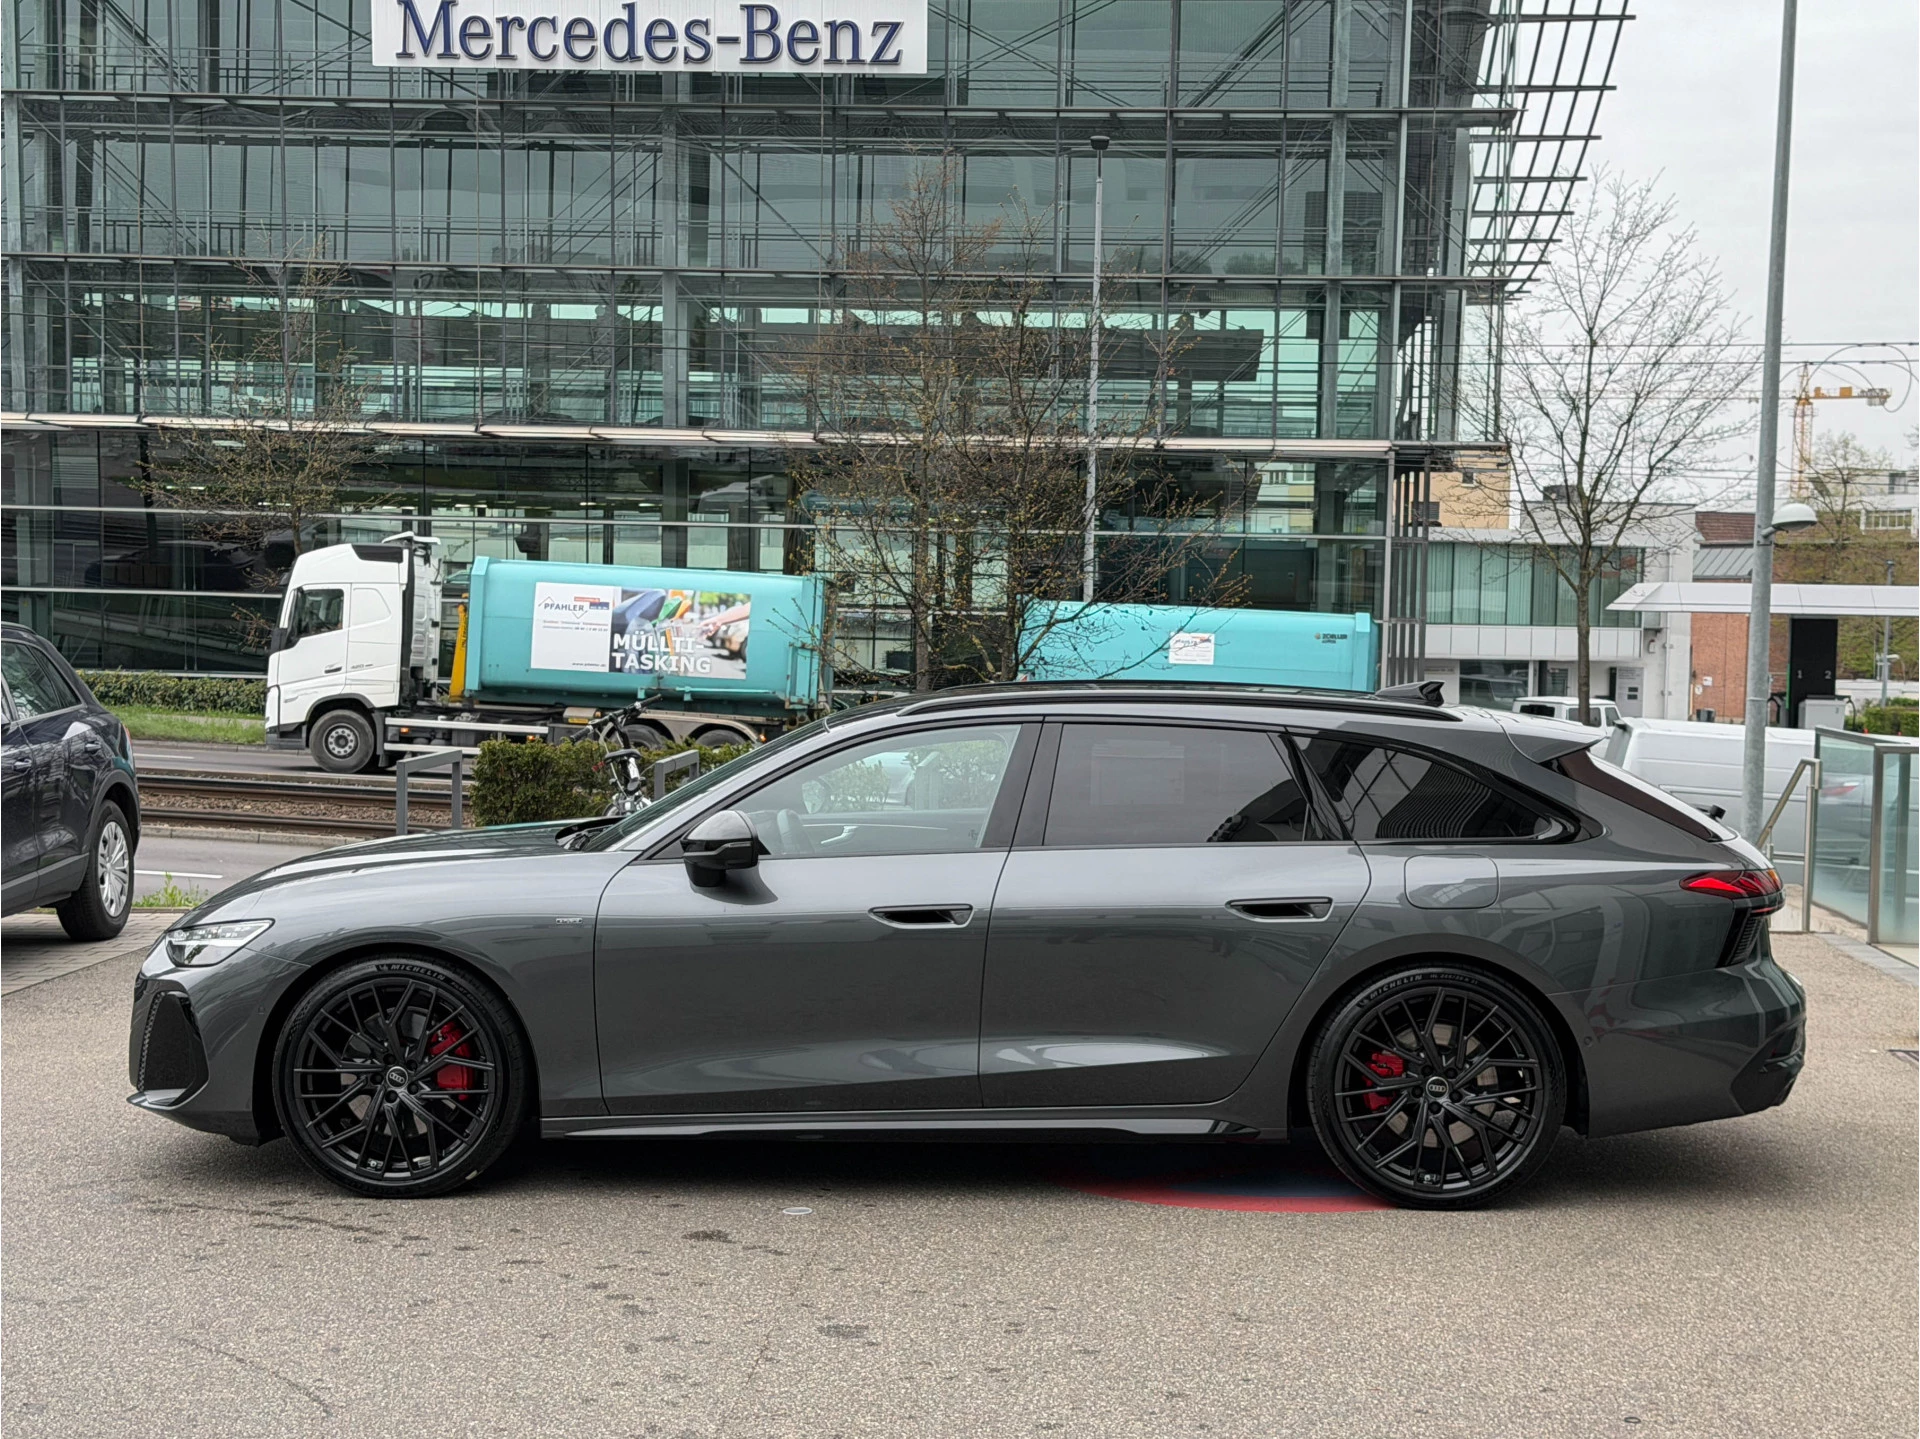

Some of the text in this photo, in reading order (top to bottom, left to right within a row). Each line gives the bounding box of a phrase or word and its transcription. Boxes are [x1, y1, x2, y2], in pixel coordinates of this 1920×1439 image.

[395, 0, 904, 65] Mercedes-Benz
[544, 602, 585, 612] PFAHLER
[612, 652, 711, 673] TASKING
[1797, 669, 1803, 679] 1
[1824, 670, 1832, 680] 2
[390, 964, 446, 981] MICHELIN
[1369, 974, 1423, 1000] MICHELIN
